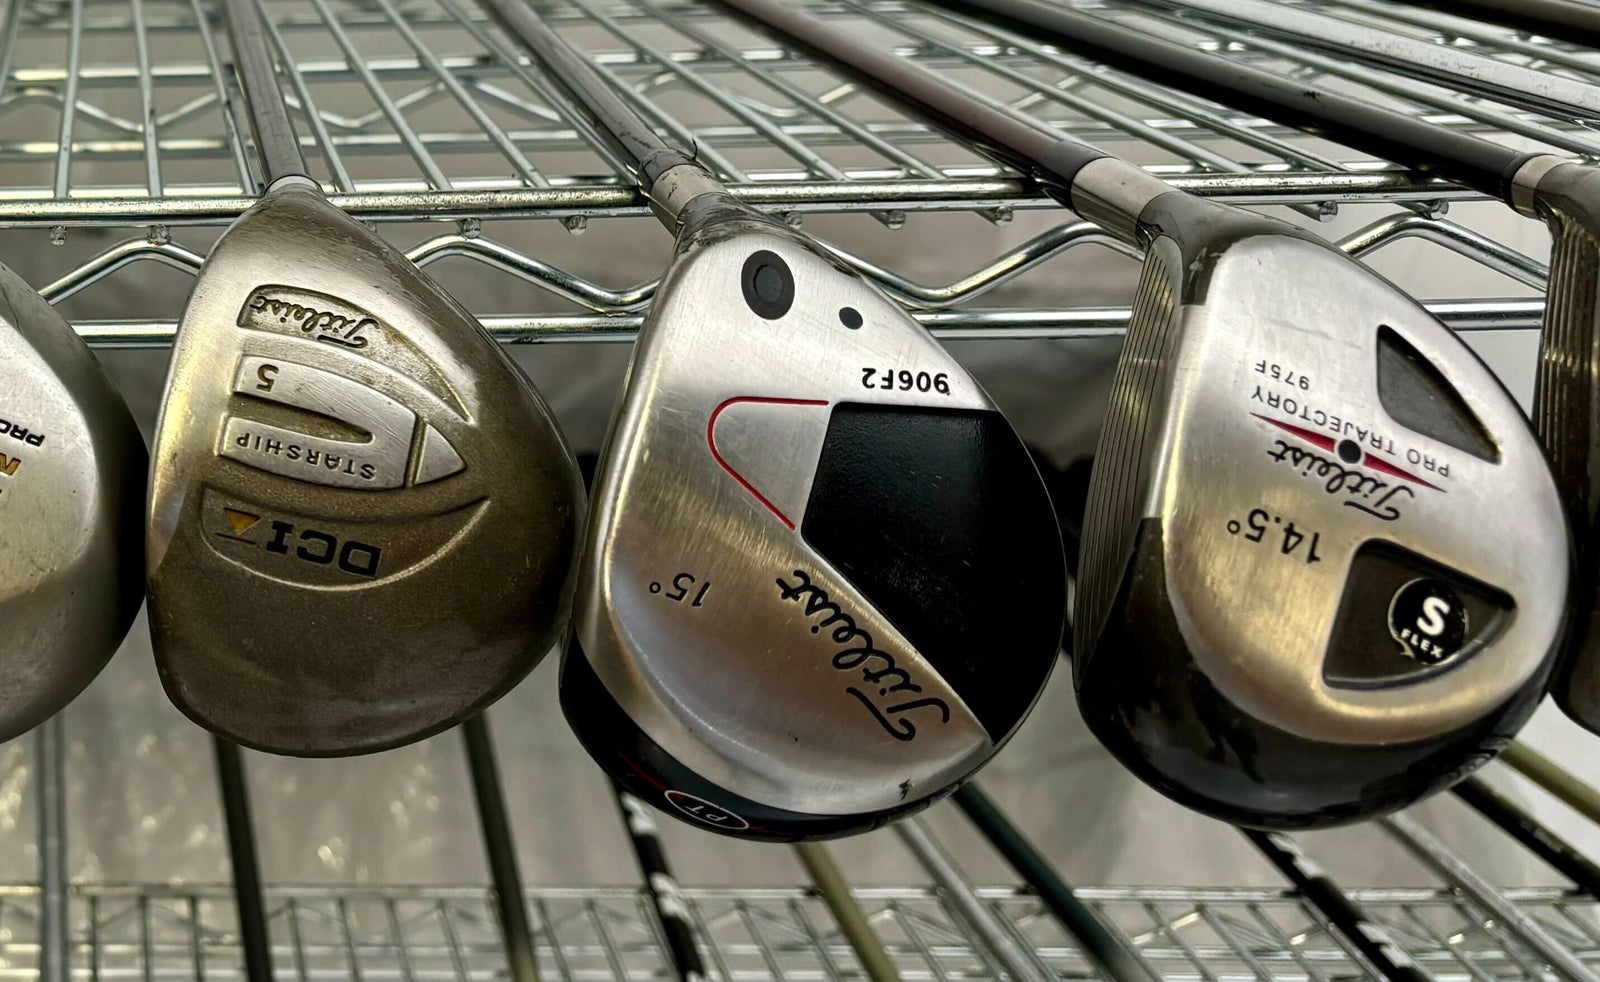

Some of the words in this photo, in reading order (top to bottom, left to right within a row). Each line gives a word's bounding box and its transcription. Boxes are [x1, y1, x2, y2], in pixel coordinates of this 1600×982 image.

[250, 295, 379, 349] Titleist
[256, 363, 279, 392] 5
[861, 367, 949, 395] 906F2
[1254, 359, 1310, 390] 975F
[1251, 385, 1397, 456] TRAJECTORY
[236, 433, 376, 480] STARSHIP
[1406, 448, 1451, 478] PRO
[1267, 439, 1415, 522] Titleist
[266, 520, 382, 578] DCI
[1227, 507, 1321, 564] 14.5°
[649, 572, 711, 607] 15°
[1416, 596, 1451, 636] S
[776, 569, 950, 742] Titleist
[1400, 628, 1443, 659] FLEX
[686, 804, 727, 822] PT
